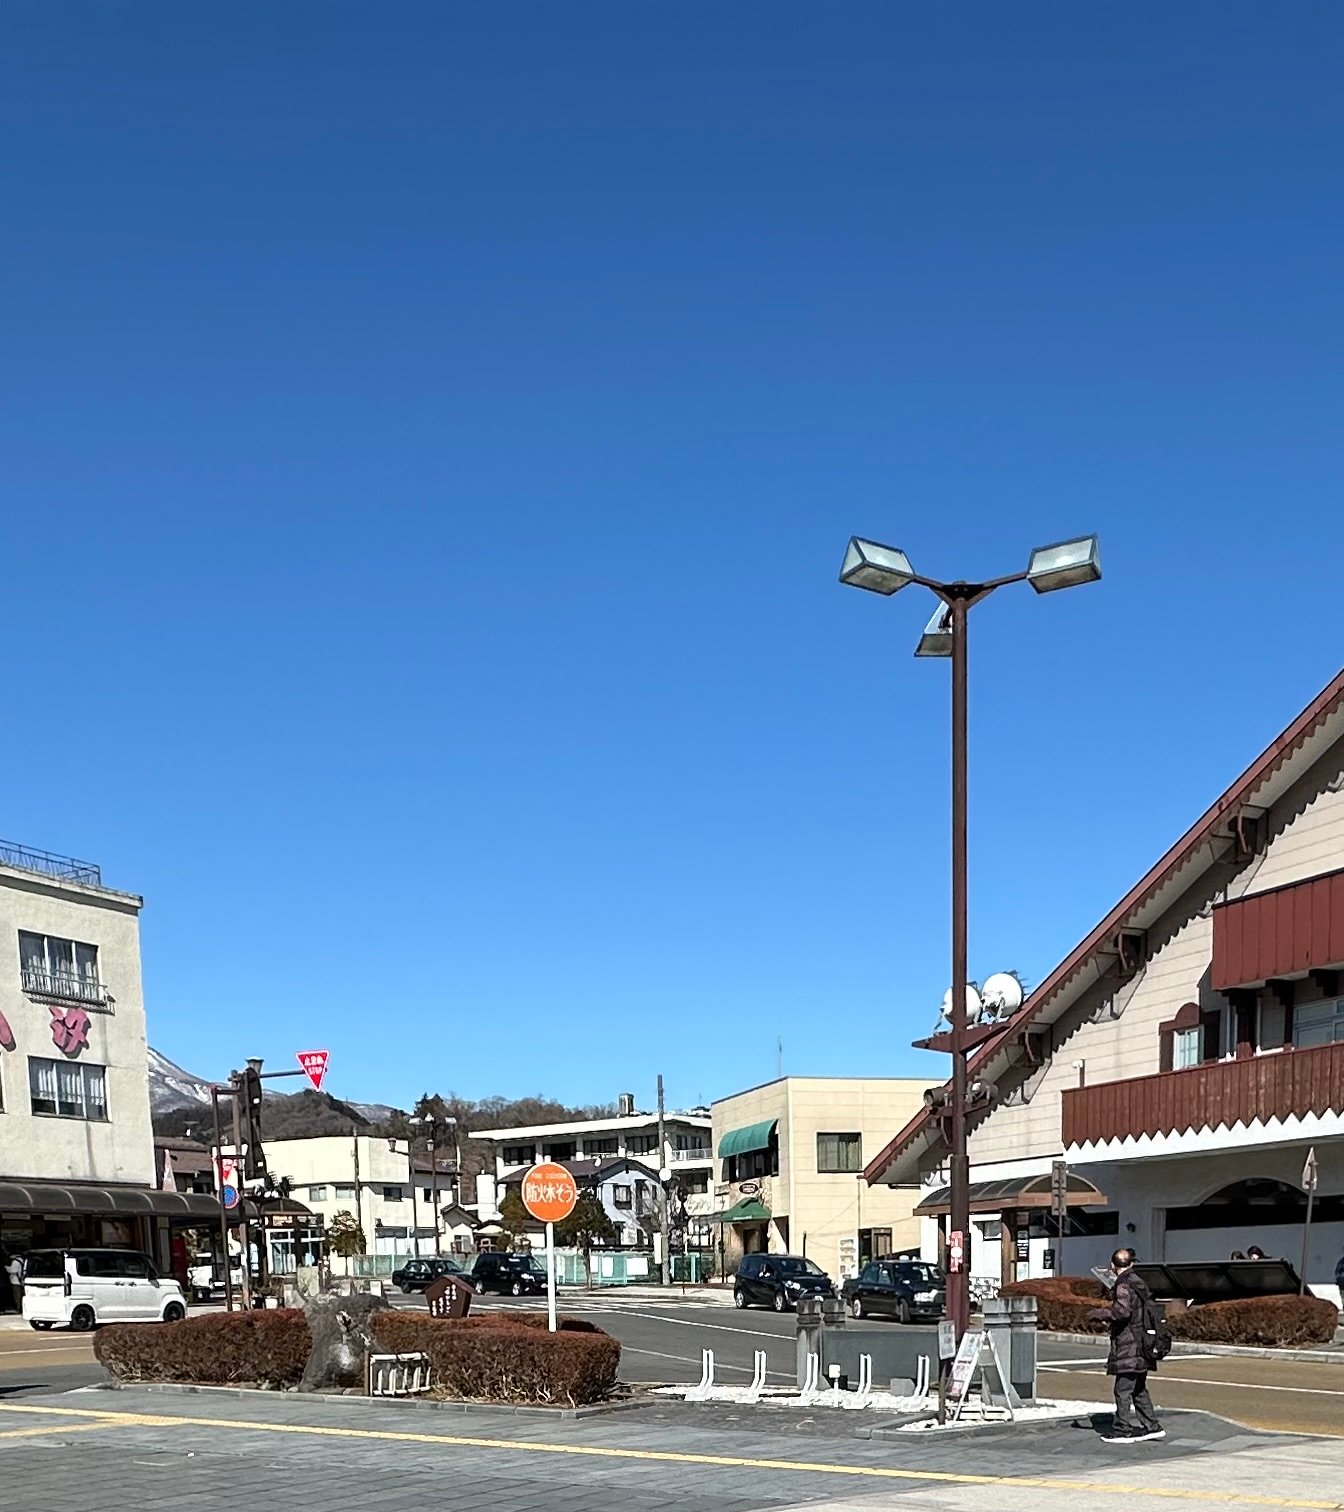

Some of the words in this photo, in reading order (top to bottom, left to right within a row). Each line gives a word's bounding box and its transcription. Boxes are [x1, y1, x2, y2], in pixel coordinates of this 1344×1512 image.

[526, 1182, 573, 1203] 防火水そう
